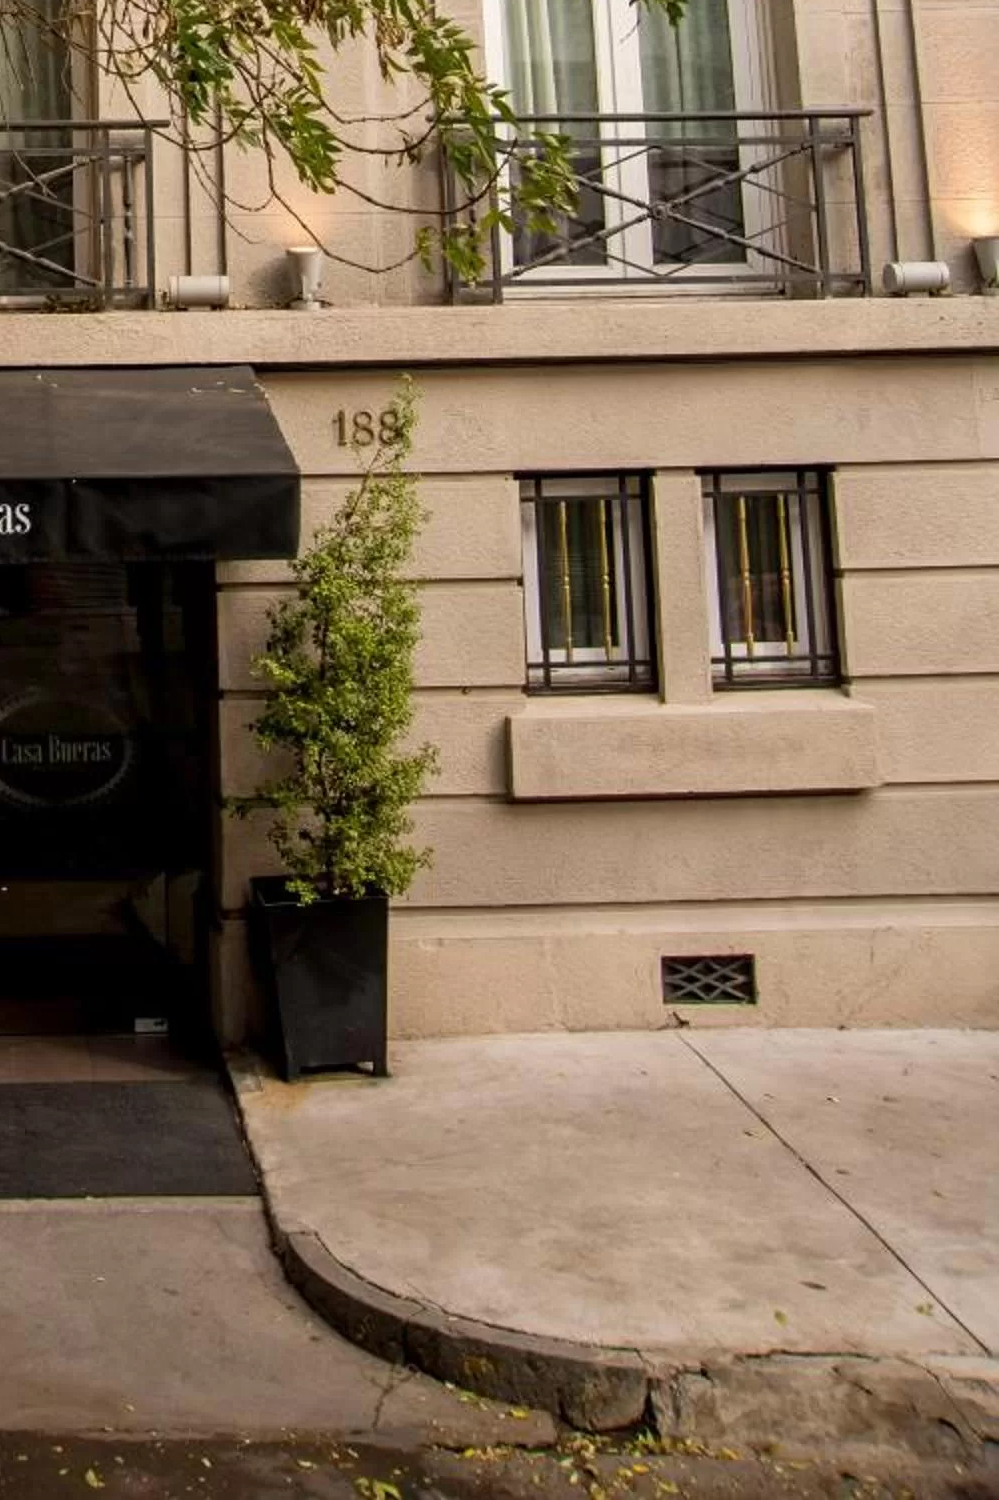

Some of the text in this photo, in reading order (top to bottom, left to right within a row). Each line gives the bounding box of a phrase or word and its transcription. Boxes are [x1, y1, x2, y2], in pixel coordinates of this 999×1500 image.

[332, 409, 403, 447] 188
[1, 734, 112, 765] Casa Bueras
